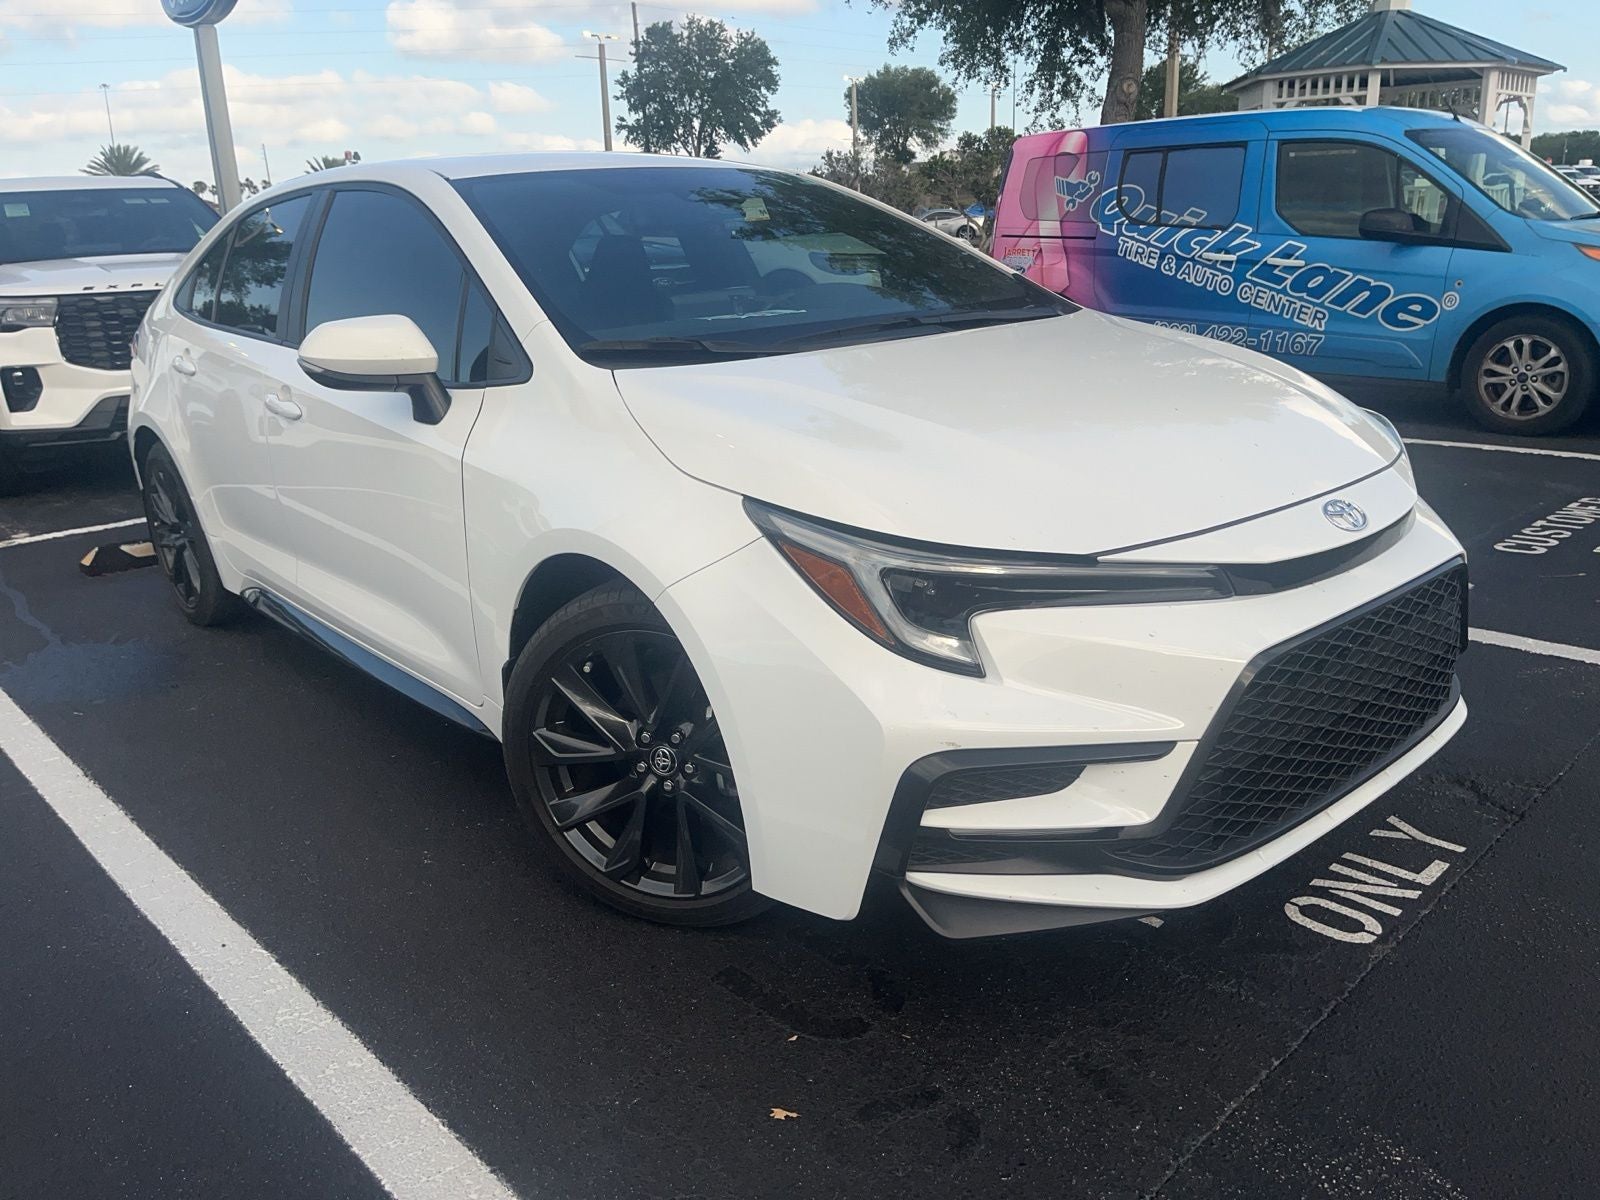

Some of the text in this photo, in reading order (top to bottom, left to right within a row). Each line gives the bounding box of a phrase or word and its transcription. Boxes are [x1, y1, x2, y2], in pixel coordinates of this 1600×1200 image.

[1090, 184, 1262, 272] Quick
[1117, 237, 1329, 331] TIRE & AUTO CENTER
[1284, 815, 1467, 944] ONLY
